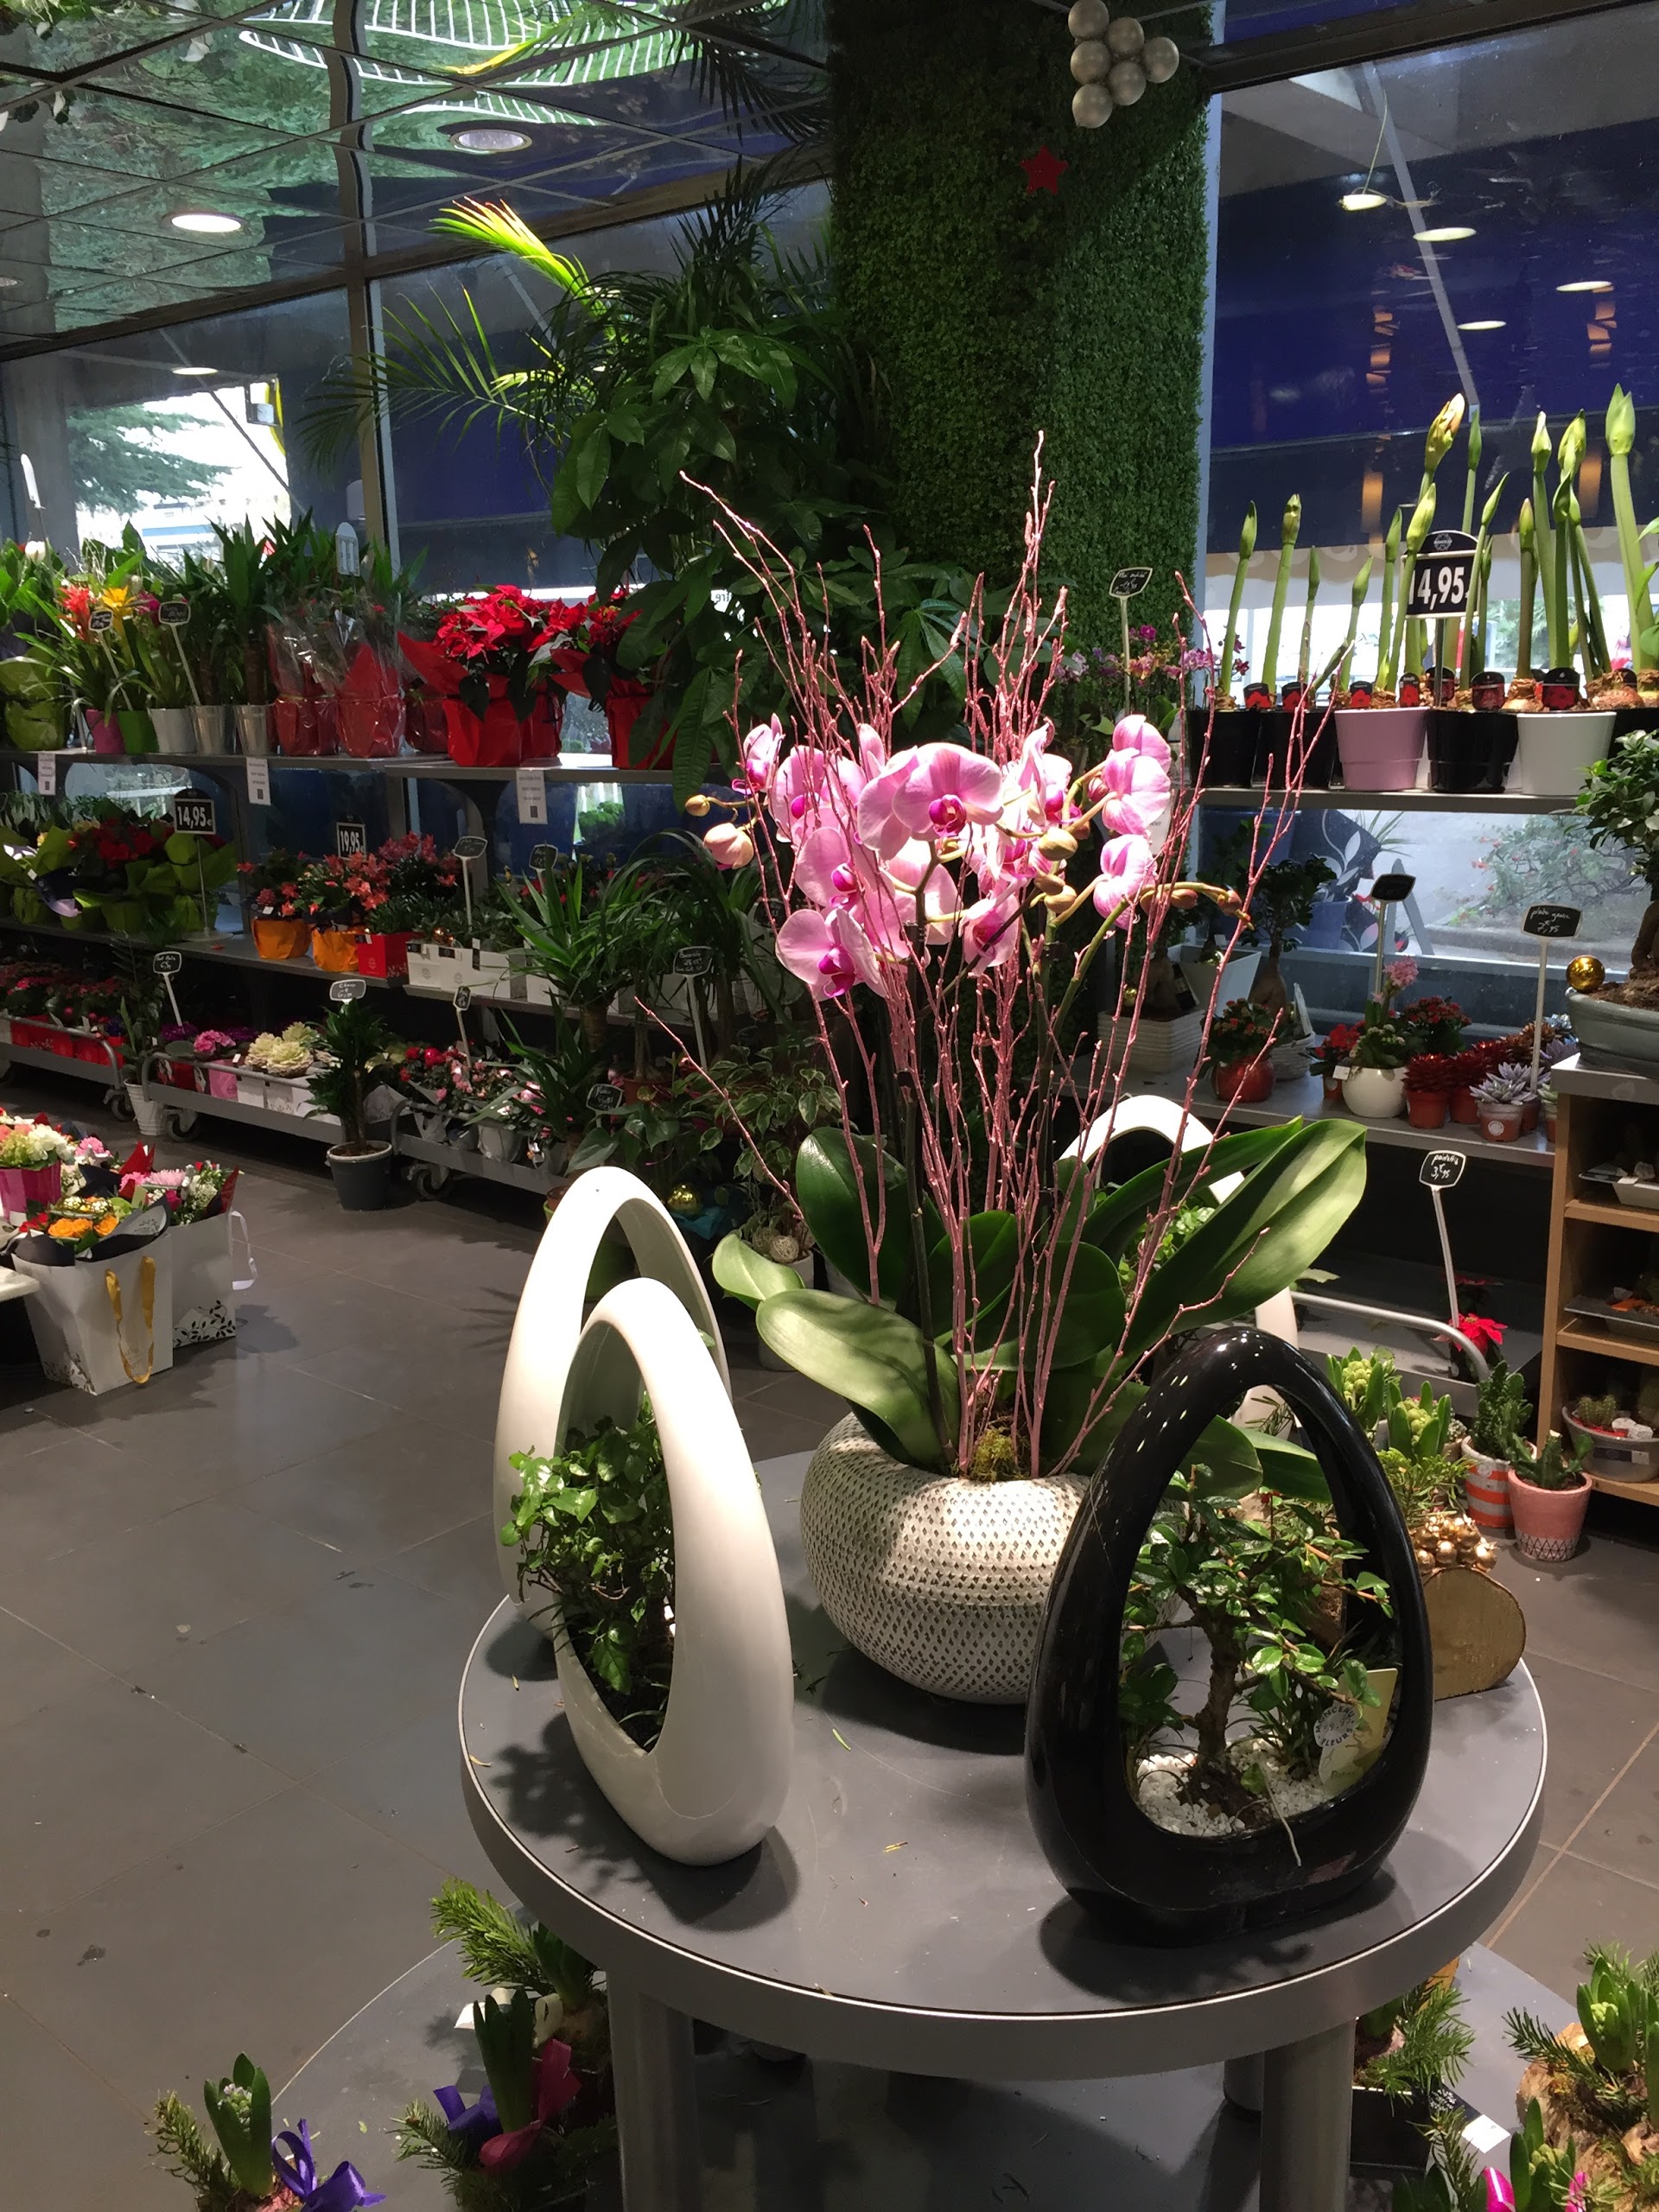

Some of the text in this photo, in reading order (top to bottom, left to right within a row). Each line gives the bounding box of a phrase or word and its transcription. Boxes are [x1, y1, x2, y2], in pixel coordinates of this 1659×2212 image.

[1408, 565, 1468, 611] 14,95
[1315, 1706, 1356, 1733] MONCEAU
[1320, 1728, 1354, 1746] FLEURS
